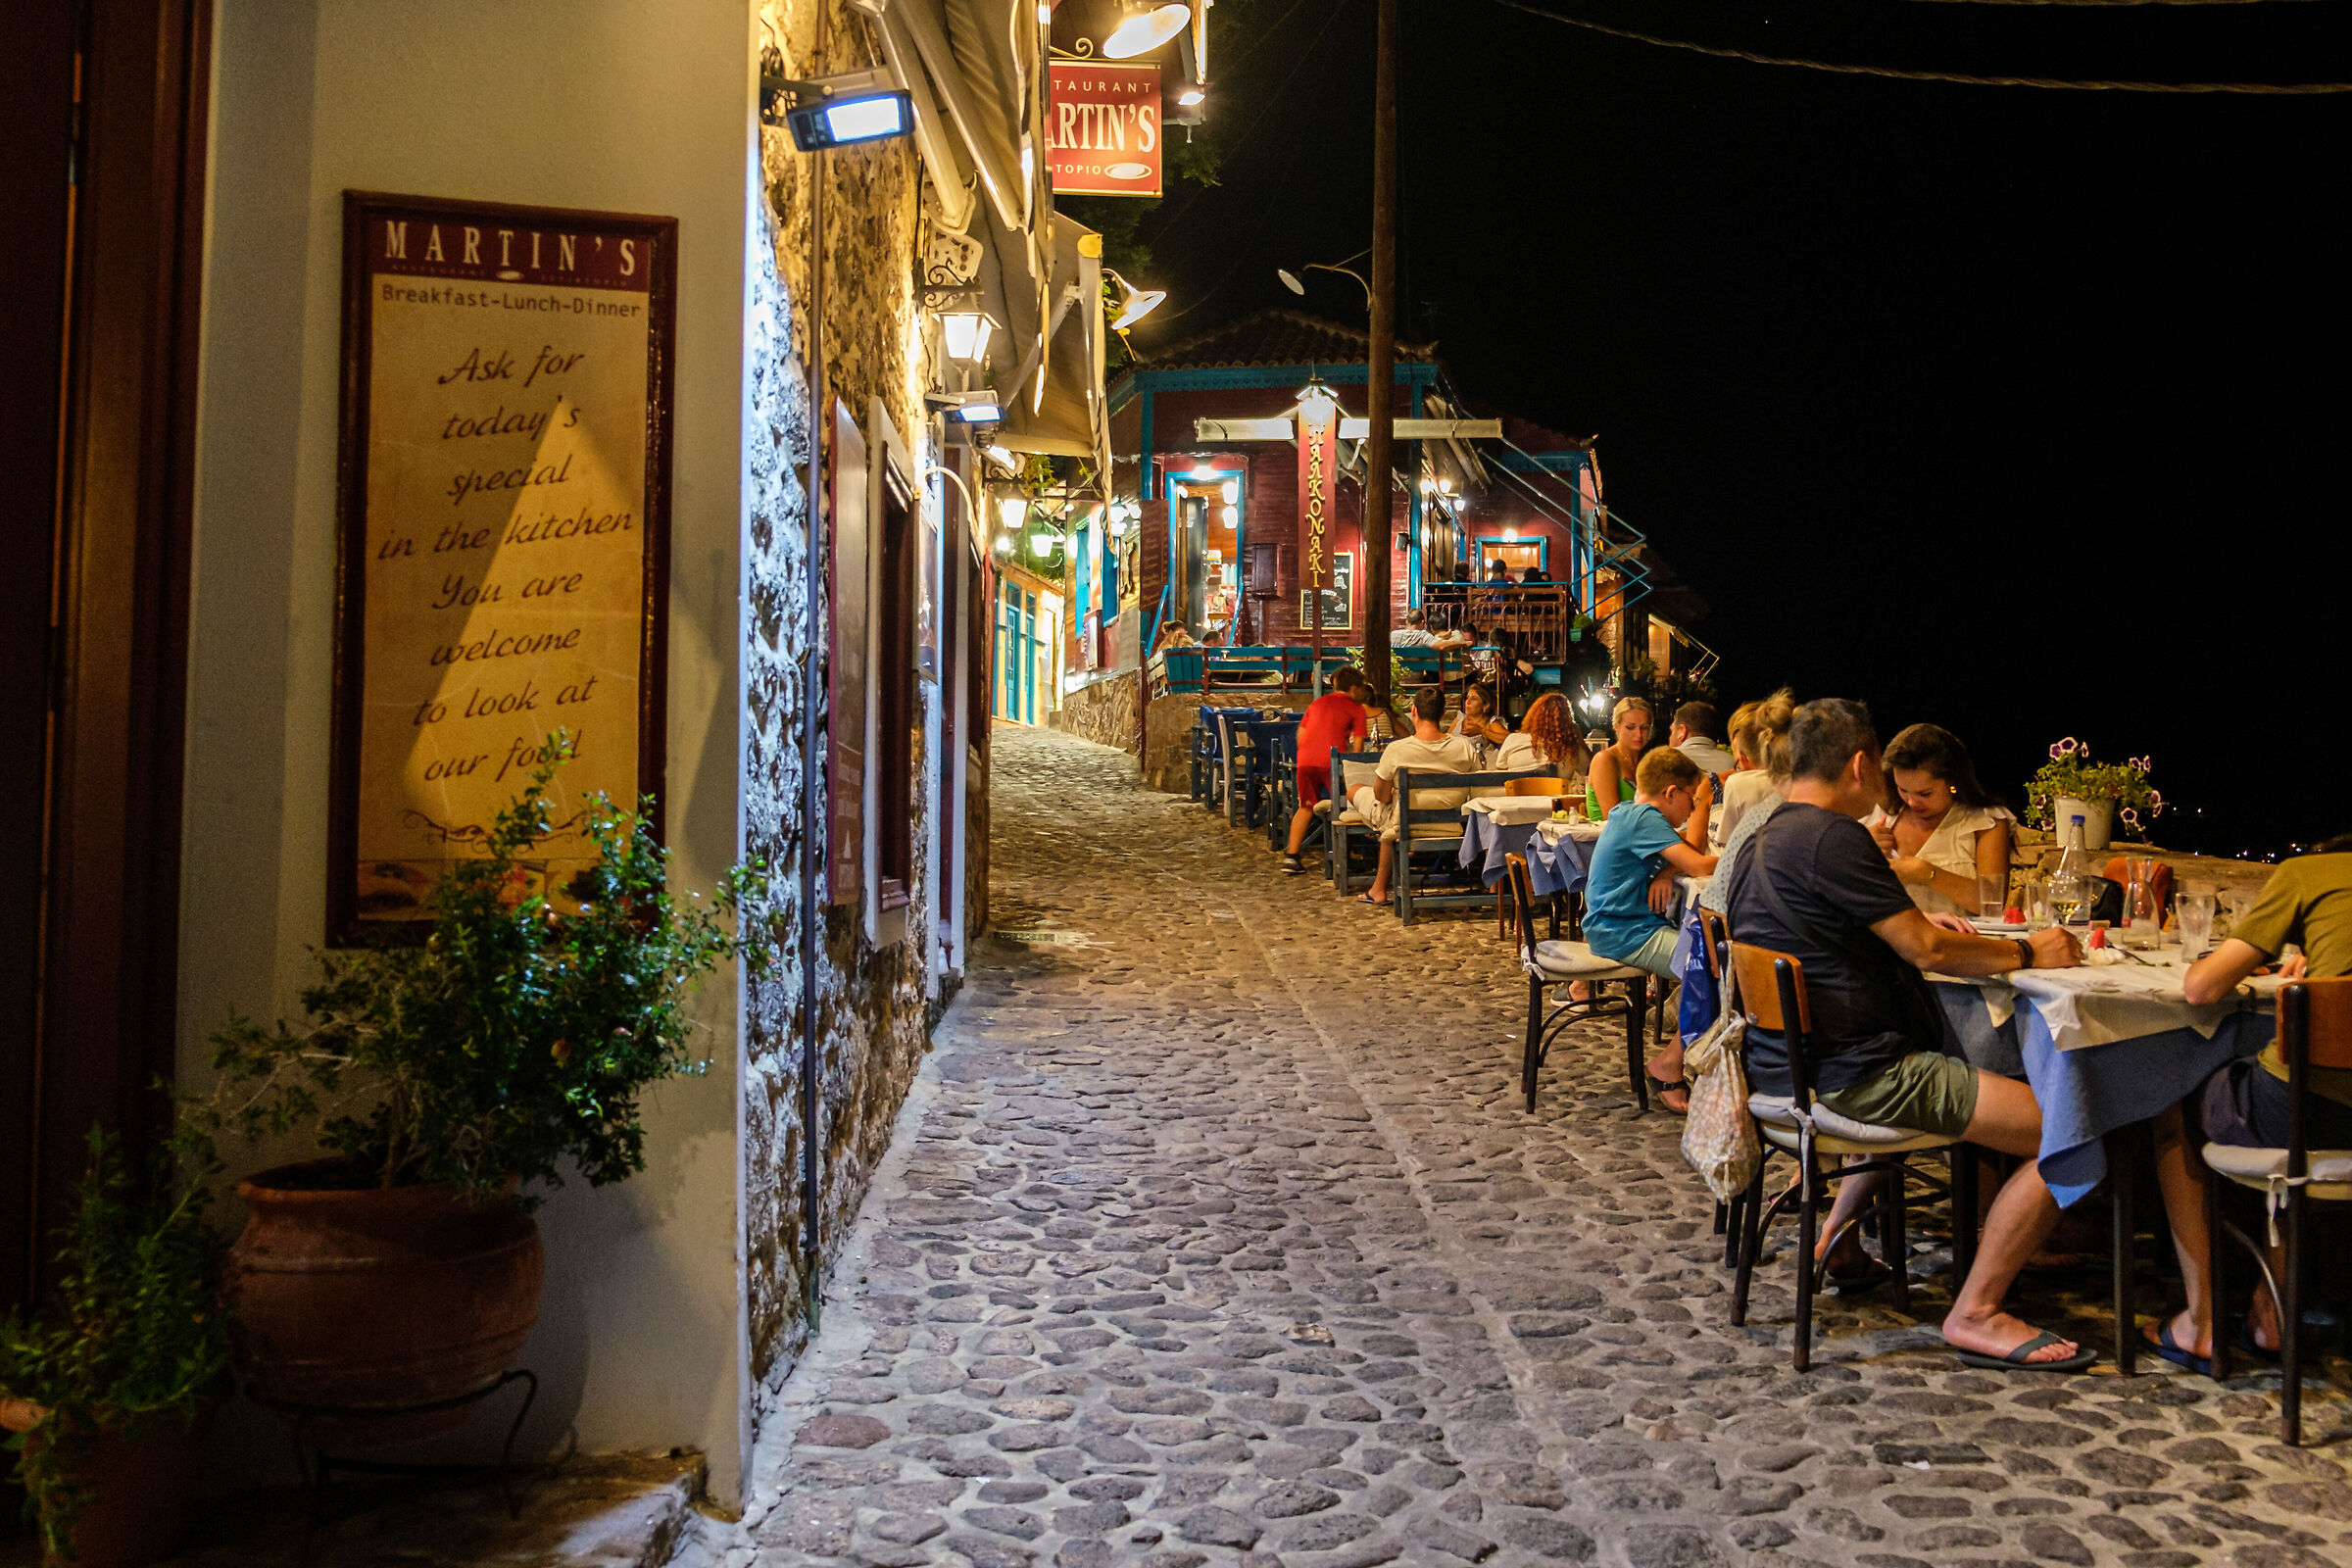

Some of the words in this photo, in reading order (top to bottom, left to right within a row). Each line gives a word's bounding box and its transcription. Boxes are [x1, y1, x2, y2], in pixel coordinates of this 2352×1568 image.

[1054, 80, 1152, 93] TAURANT
[1051, 103, 1155, 153] RTIN'S
[384, 220, 636, 276] MARTIN'S
[382, 284, 641, 318] Breakfast-Lunch-Dinner
[437, 348, 514, 385] Ask
[523, 345, 585, 388] for
[442, 394, 581, 442] today's
[447, 454, 573, 507] special
[377, 530, 414, 561] in
[433, 521, 491, 554] the
[505, 507, 634, 546] kitchen
[431, 574, 503, 610] You
[520, 571, 583, 600] are
[429, 628, 581, 667] welcome
[413, 699, 446, 726] to
[464, 680, 538, 719] look
[556, 675, 599, 706] at
[423, 753, 488, 781] our
